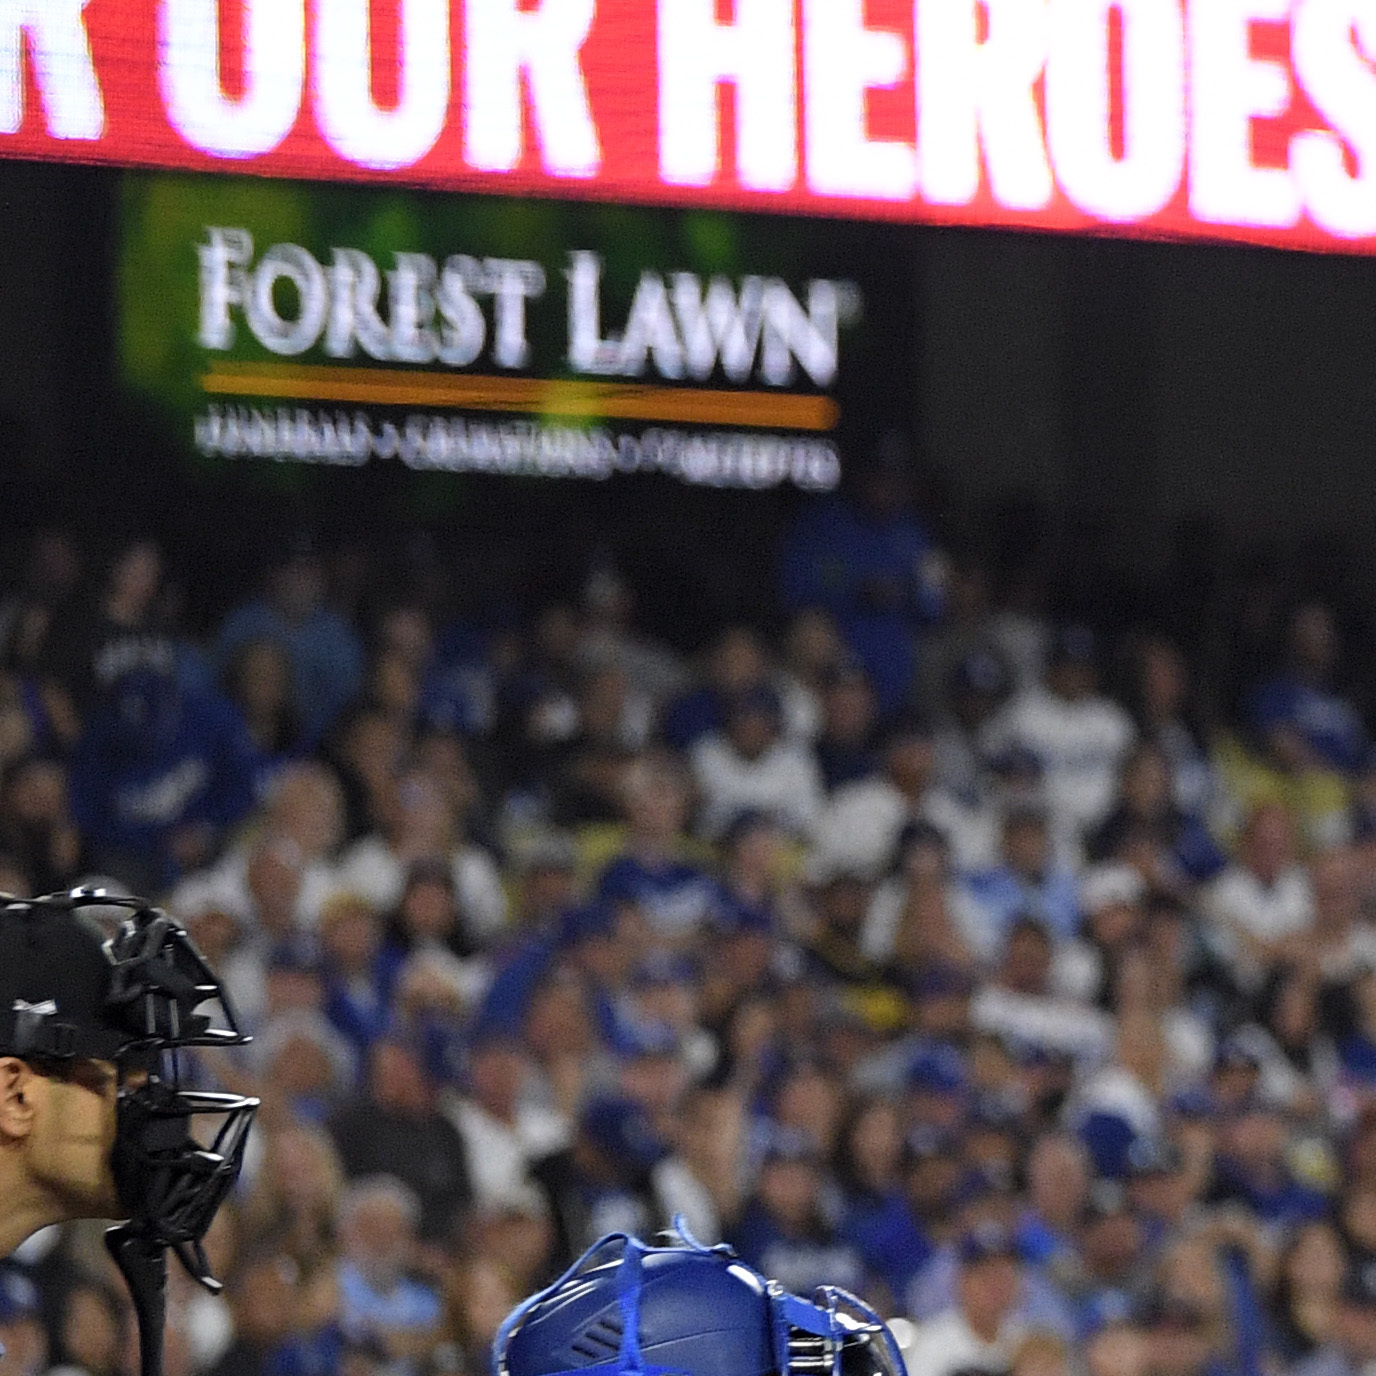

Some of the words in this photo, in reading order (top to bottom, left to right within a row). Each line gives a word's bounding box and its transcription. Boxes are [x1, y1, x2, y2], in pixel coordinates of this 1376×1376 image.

[155, 0, 602, 180] OUR
[197, 226, 546, 370] FOREST
[564, 250, 840, 388] LAWN
